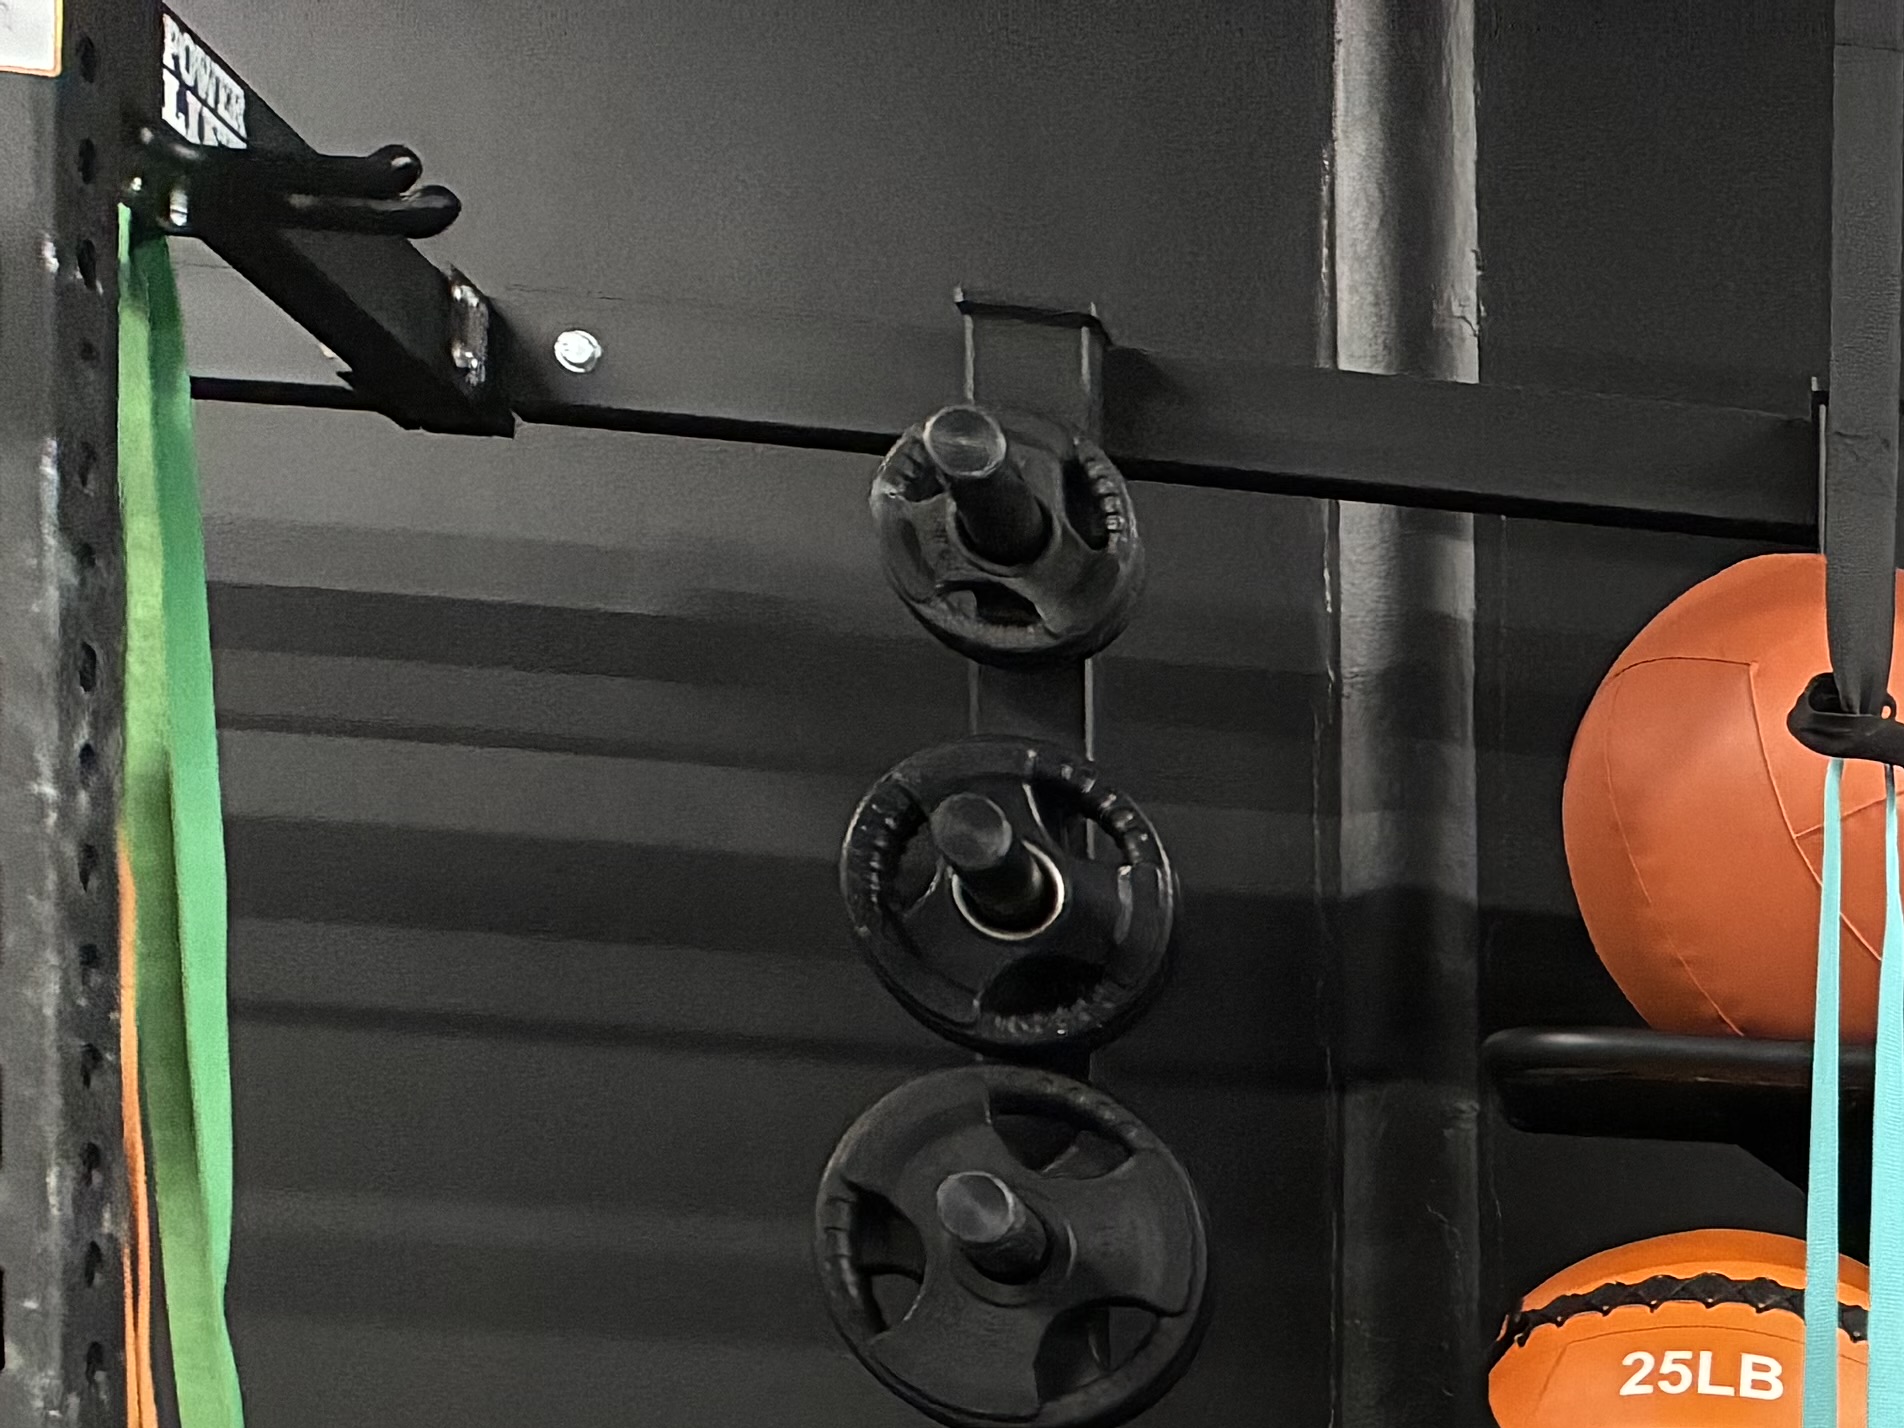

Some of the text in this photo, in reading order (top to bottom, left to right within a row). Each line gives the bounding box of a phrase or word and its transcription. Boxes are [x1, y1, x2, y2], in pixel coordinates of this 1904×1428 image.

[161, 67, 247, 150] LIF
[162, 12, 247, 140] POWER
[1619, 1350, 1785, 1401] 25LB
